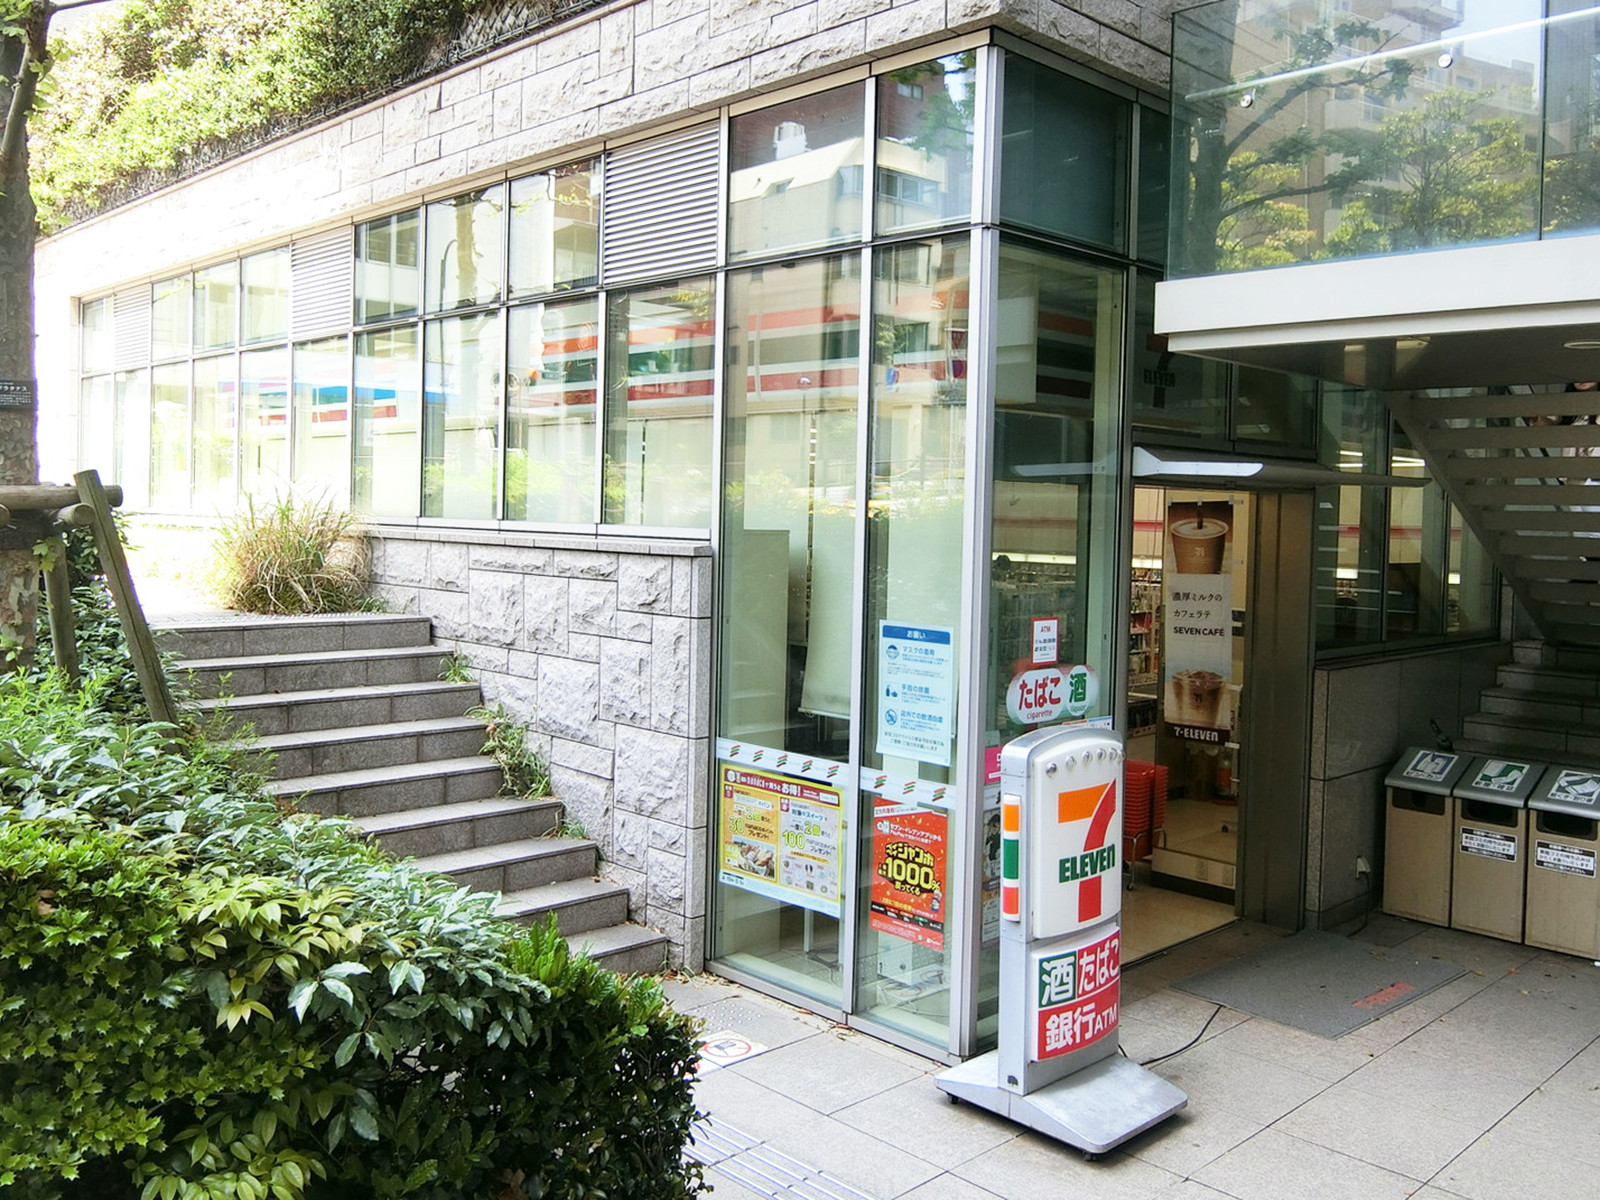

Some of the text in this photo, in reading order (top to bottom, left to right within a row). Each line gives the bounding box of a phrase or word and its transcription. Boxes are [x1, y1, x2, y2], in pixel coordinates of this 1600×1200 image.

[1172, 592, 1223, 602] 濃厚ミルクの
[1173, 609, 1211, 619] カフェラテ
[1019, 673, 1087, 710] たばこ 酒
[1027, 709, 1053, 720] cigarette
[783, 830, 805, 849] 100
[1042, 938, 1119, 1005] 酒 たばこ
